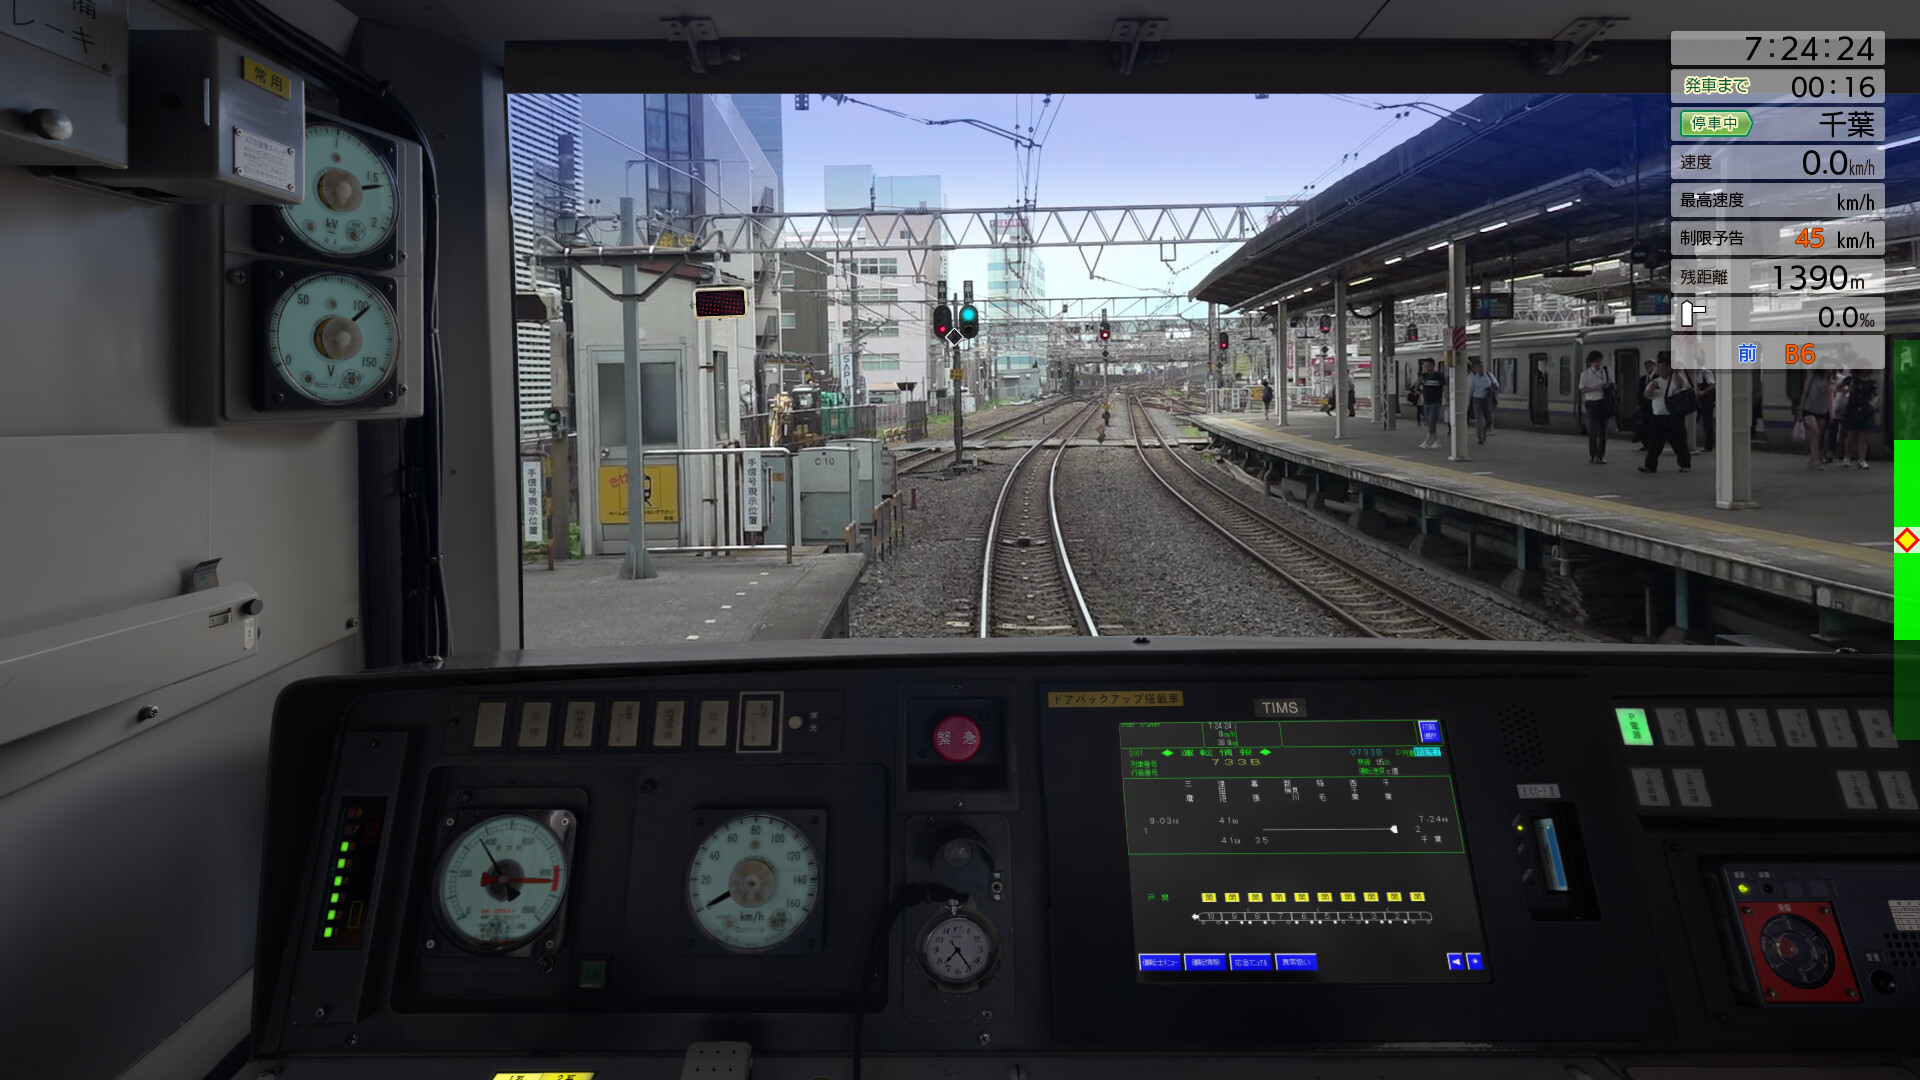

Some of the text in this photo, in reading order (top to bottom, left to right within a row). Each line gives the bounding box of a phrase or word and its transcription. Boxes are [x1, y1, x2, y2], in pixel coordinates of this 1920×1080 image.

[255, 64, 283, 93] 常用
[326, 218, 338, 230] kV
[371, 217, 378, 228] 2
[297, 294, 310, 305] 50
[354, 300, 368, 311] 100
[286, 355, 292, 366] 0
[362, 356, 377, 368] 150
[327, 364, 336, 377] V
[815, 457, 835, 467] C 10
[747, 457, 759, 526] 手信号現示位置
[527, 467, 539, 536] 手信号現示位置
[1053, 693, 1181, 705] ドアバックアップ搭載車
[1261, 701, 1299, 715] TIMS
[937, 731, 977, 746] 緊急
[1211, 758, 1261, 767] 733B
[352, 825, 360, 834] 7
[751, 825, 761, 835] 80
[727, 833, 738, 843] 60
[771, 833, 785, 843] 100
[709, 851, 720, 860] 40
[787, 851, 801, 861] 120
[701, 875, 711, 885] 20
[793, 875, 807, 885] 140
[786, 898, 801, 908] 160
[335, 910, 344, 919] 2
[740, 911, 764, 923] km/h
[974, 935, 980, 944] 2
[932, 946, 939, 954] 9
[955, 968, 962, 976] 6
